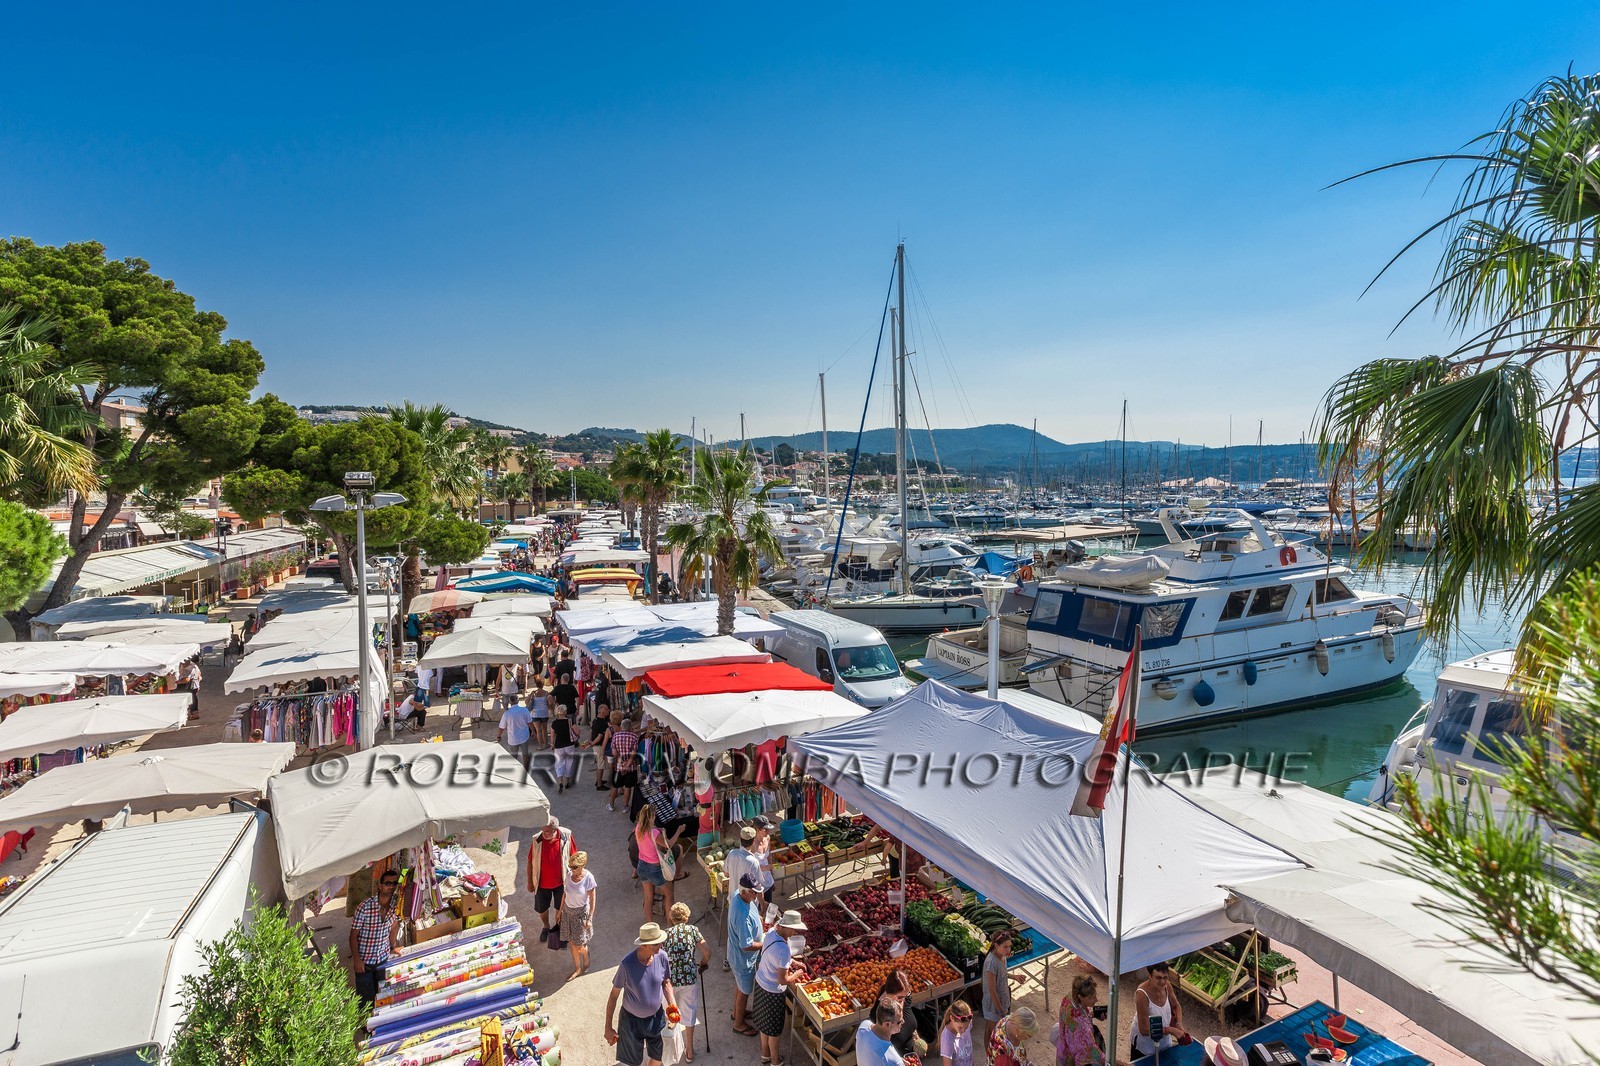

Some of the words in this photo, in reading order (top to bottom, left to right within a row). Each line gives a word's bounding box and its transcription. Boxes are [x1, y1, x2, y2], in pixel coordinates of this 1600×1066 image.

[144, 575, 155, 583] BAR
[937, 647, 956, 661] CAPTAIN
[956, 654, 971, 667] ROSS
[1145, 661, 1151, 669] TL
